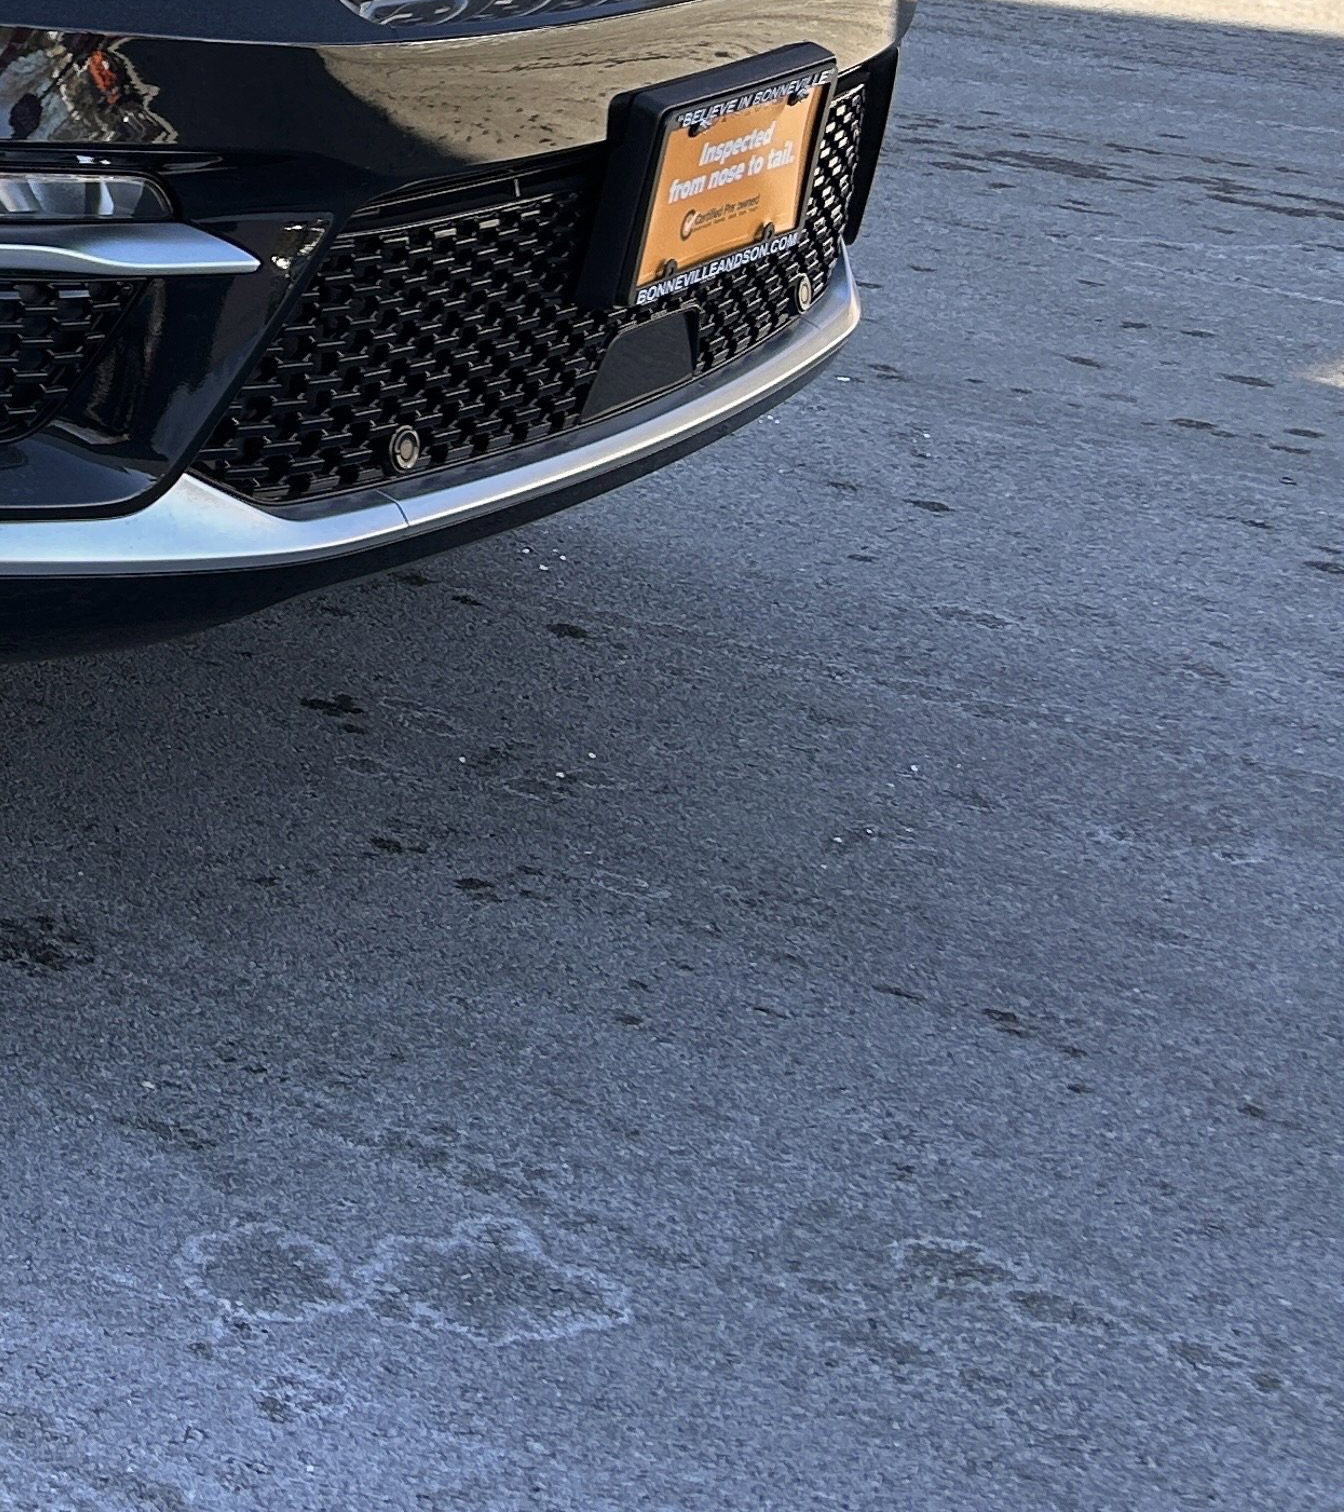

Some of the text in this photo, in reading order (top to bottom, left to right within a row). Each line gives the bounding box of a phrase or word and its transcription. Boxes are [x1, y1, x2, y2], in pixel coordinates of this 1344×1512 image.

[738, 95, 754, 111] IN
[698, 120, 777, 167] Inspected
[668, 140, 795, 205] from nose to tail.
[636, 233, 800, 305] BONNEVILLEANDSON.COM
